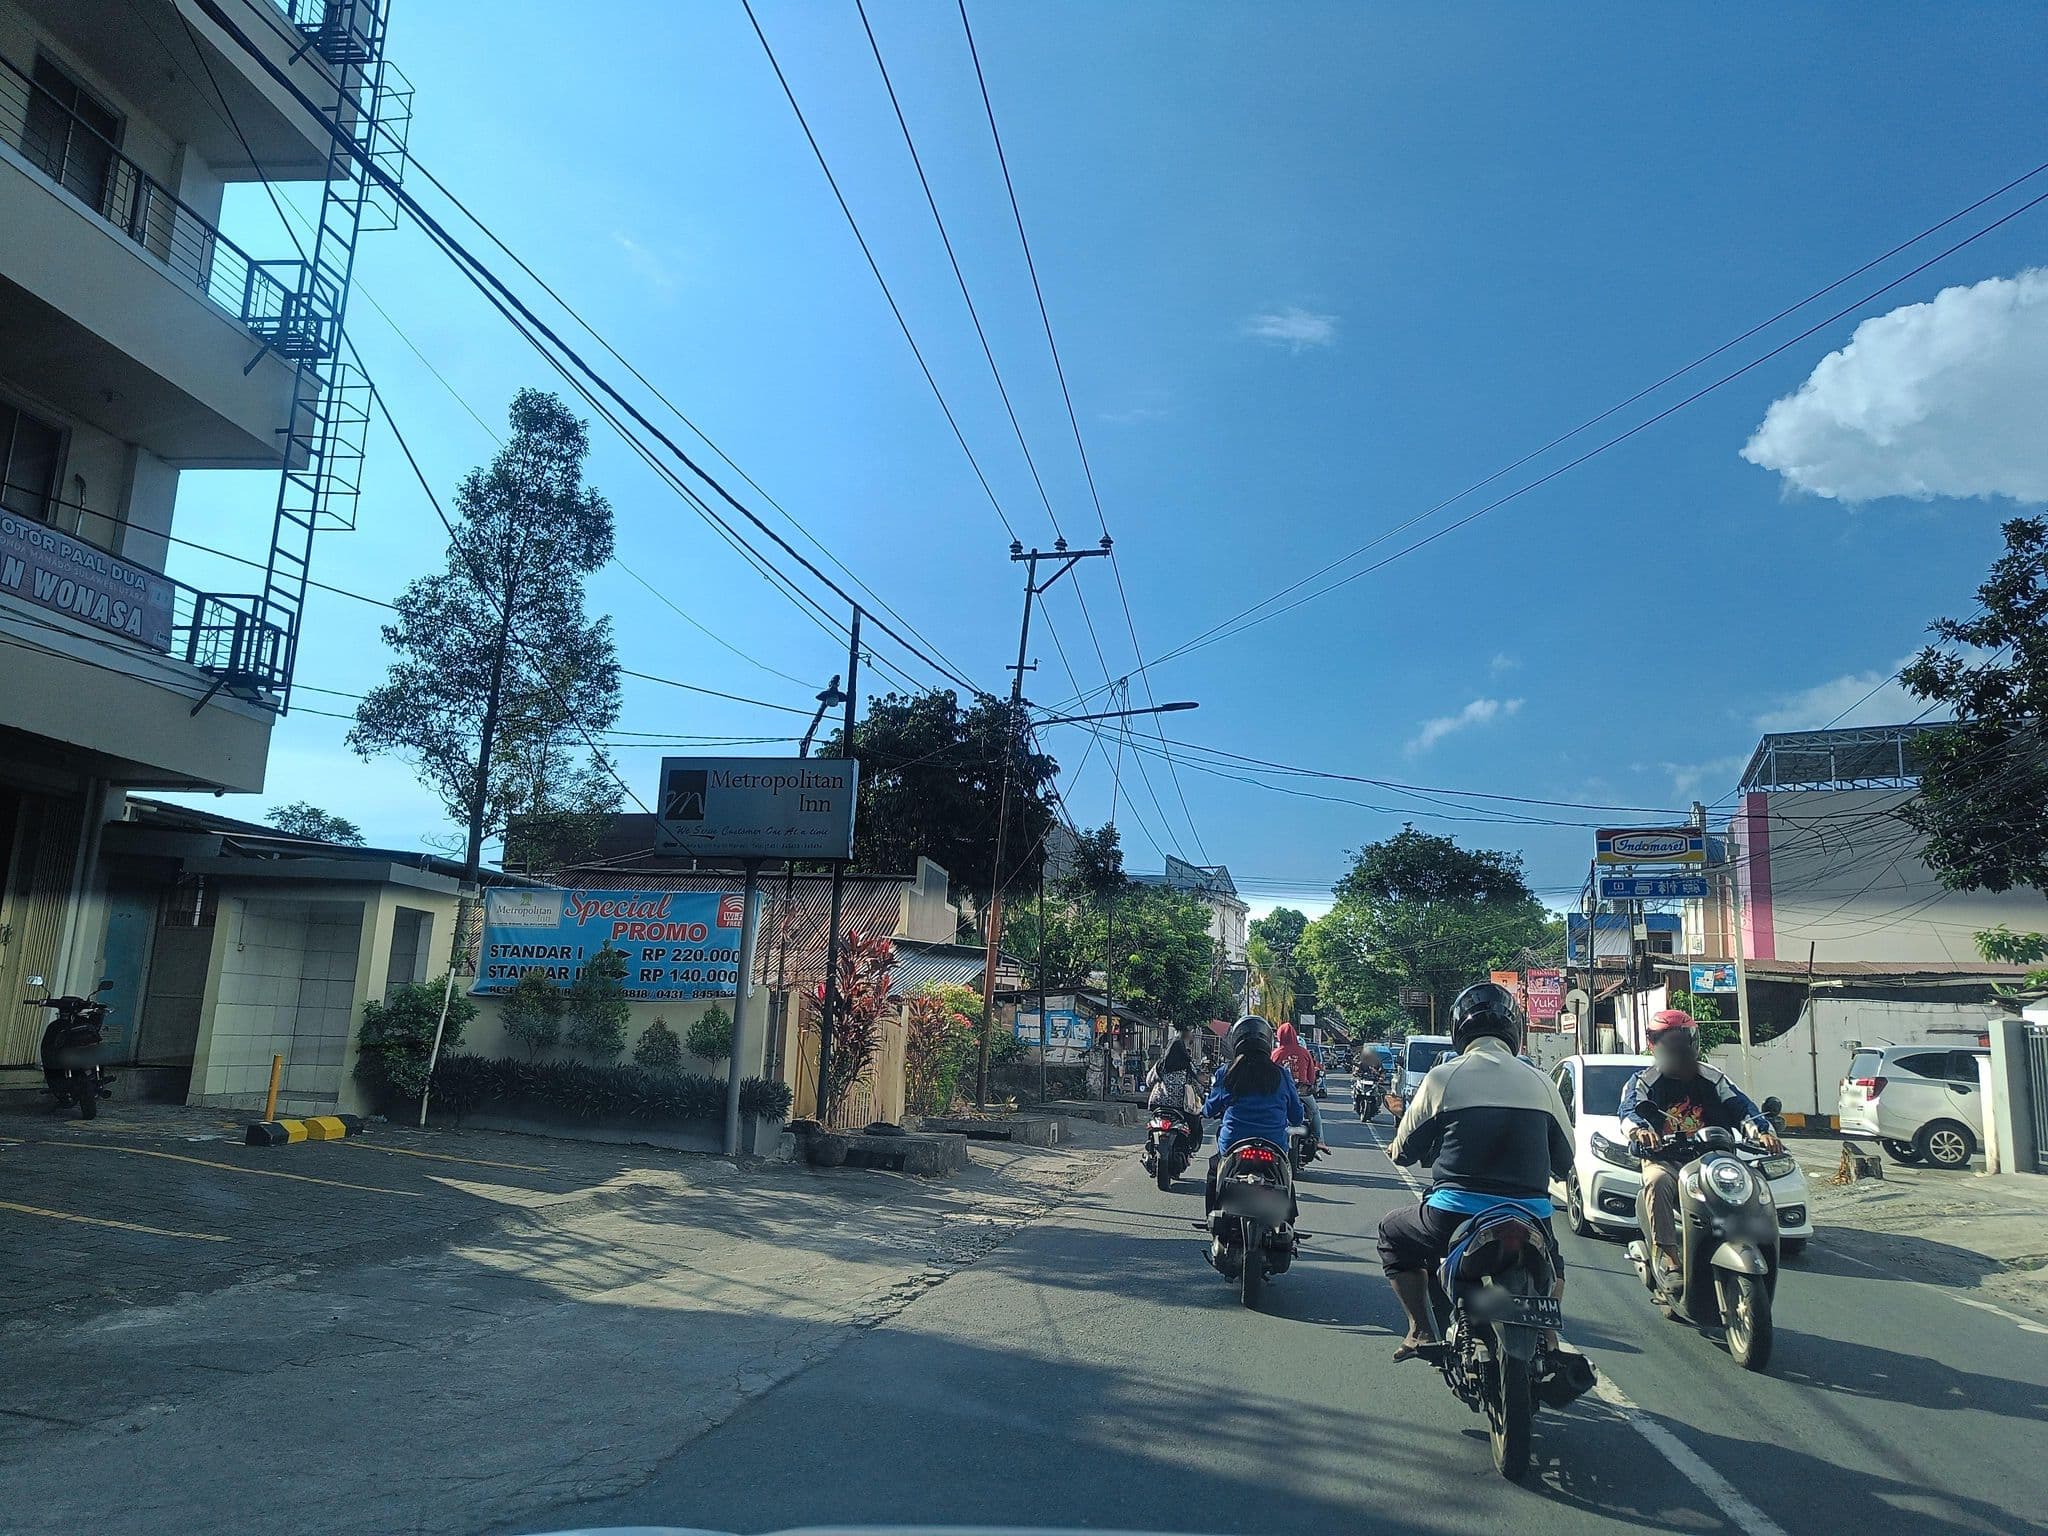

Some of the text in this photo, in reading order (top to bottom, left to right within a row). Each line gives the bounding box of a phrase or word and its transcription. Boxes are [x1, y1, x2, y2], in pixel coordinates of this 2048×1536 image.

[0, 517, 55, 553] OTOR
[60, 543, 106, 576] PAAL
[111, 564, 146, 592] DUA
[33, 567, 142, 637] WONASA
[711, 768, 845, 796] Metropolitan
[798, 794, 832, 812] Inn
[675, 825, 690, 835] We
[1617, 839, 1685, 852] Indomaret
[496, 905, 552, 917] Metropolitan
[563, 891, 673, 926] Special
[611, 921, 708, 942] PROMO
[489, 944, 740, 964] STANDAR I RP 220.000
[639, 968, 664, 982] RP
[669, 968, 738, 984] 140.000
[1531, 996, 1557, 1008] Yuki
